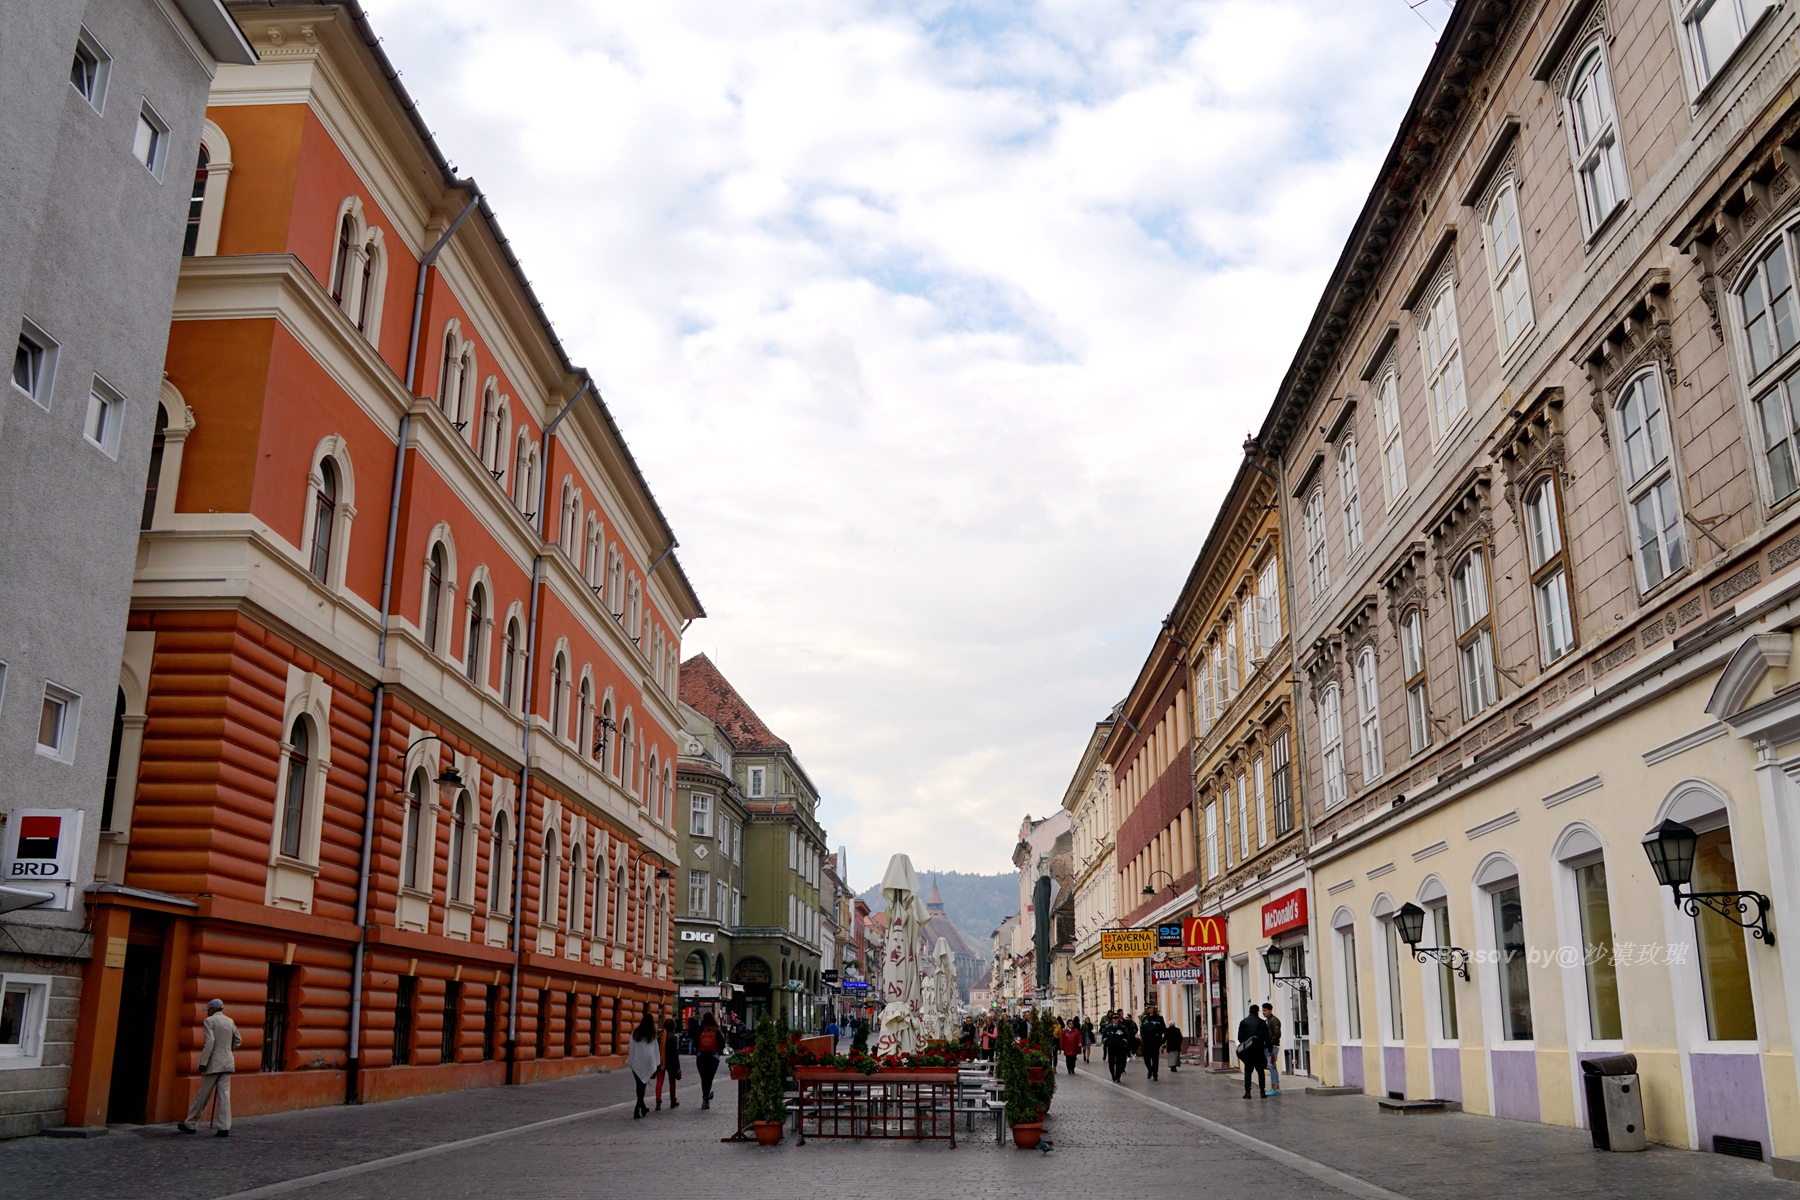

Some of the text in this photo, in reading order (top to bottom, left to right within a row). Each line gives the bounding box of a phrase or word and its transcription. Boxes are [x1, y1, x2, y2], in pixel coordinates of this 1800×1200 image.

[11, 862, 59, 876] BRD
[1264, 898, 1299, 931] McDonald's
[680, 930, 715, 943] DIGI
[1159, 927, 1181, 936] 9D
[1111, 933, 1152, 943] TAVERNA
[1154, 969, 1200, 979] TRADUCERI
